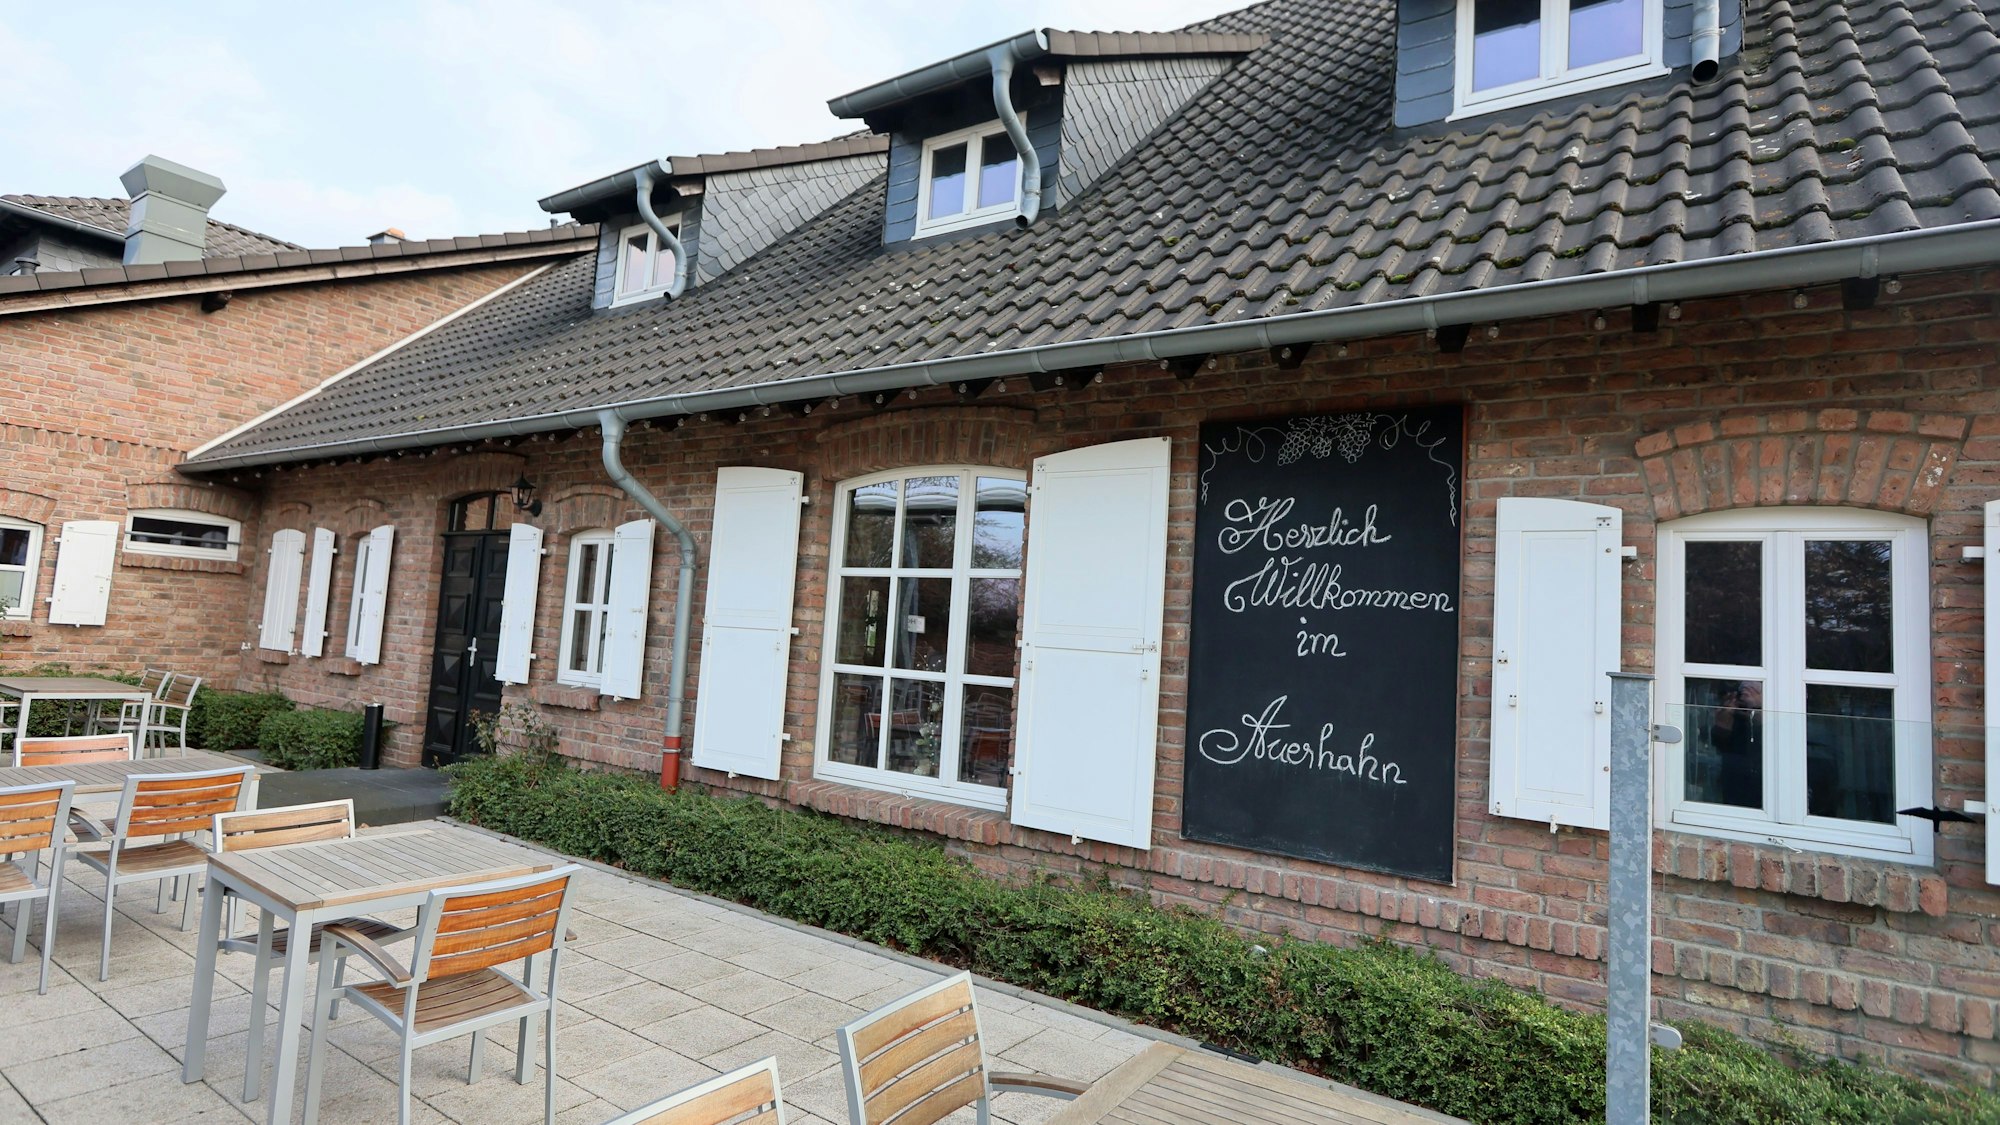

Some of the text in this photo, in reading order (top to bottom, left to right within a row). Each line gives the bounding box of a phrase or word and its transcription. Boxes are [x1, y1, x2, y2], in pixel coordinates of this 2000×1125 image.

[1218, 496, 1391, 554] Herzlich
[1224, 556, 1453, 612] Willkommen
[1296, 617, 1346, 657] im
[1199, 694, 1407, 784] Auerhahn
